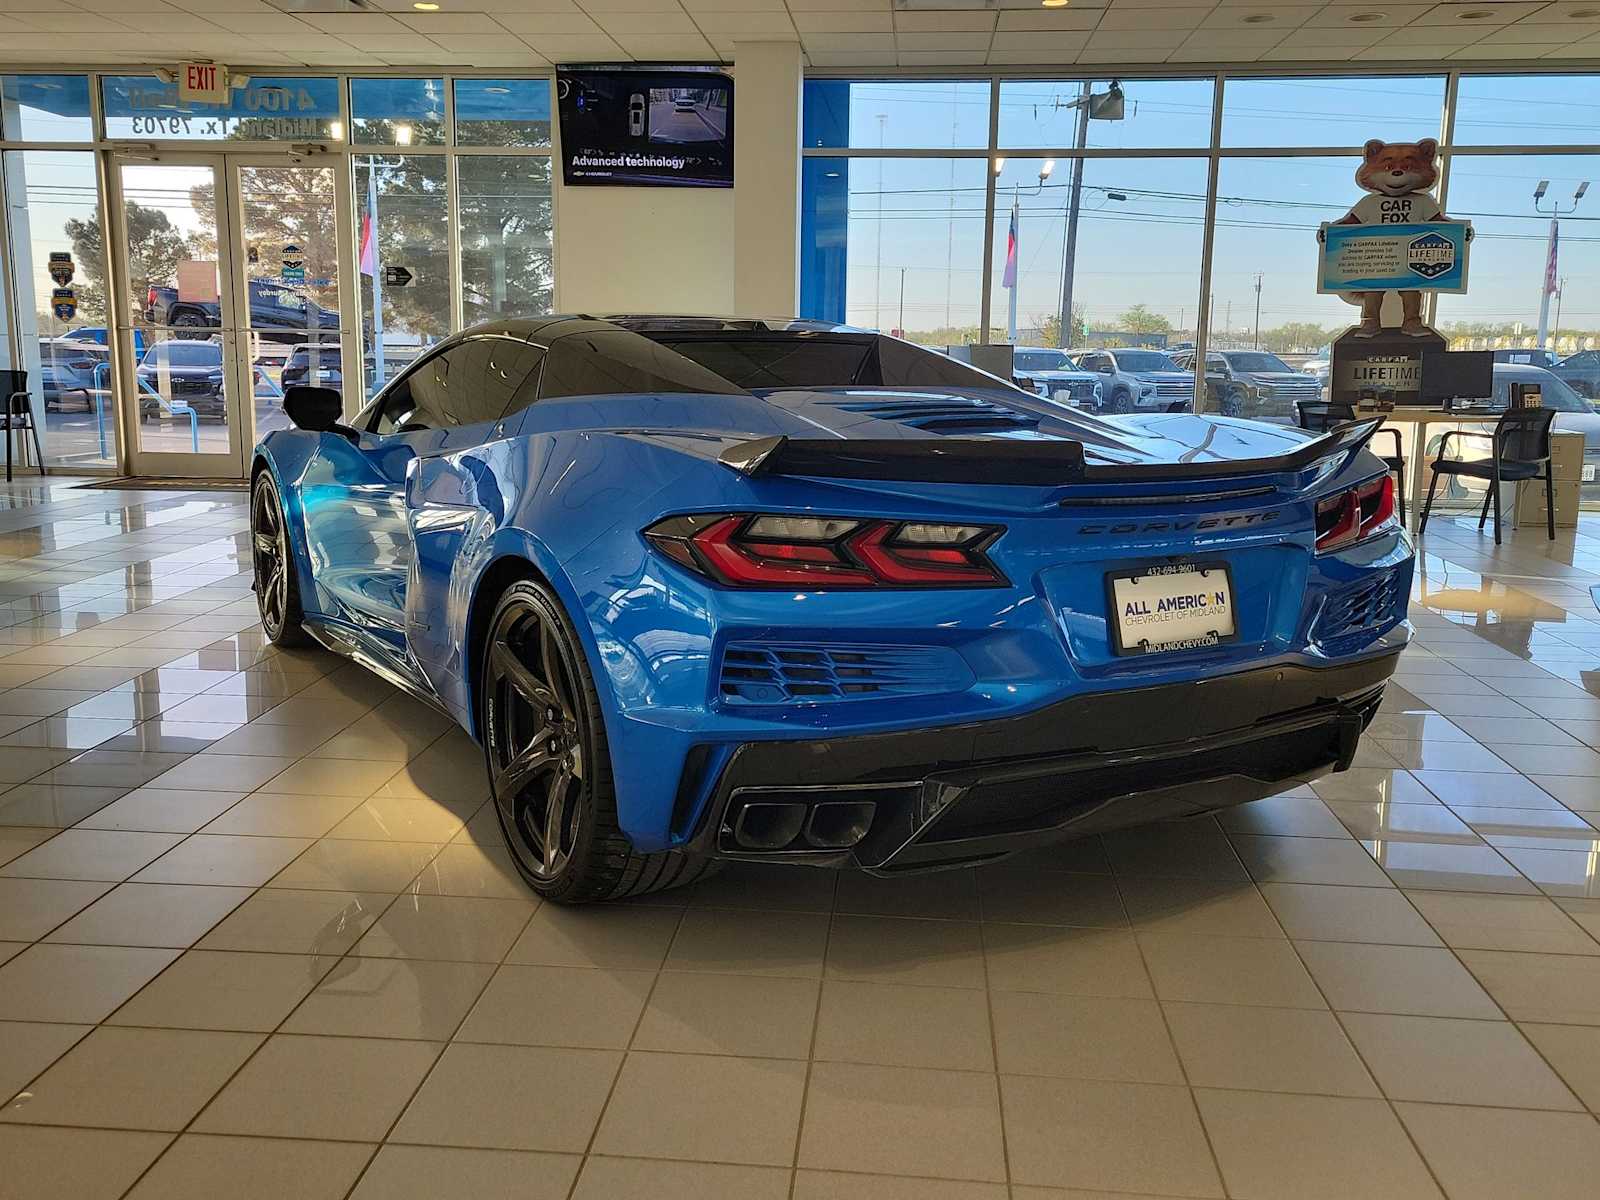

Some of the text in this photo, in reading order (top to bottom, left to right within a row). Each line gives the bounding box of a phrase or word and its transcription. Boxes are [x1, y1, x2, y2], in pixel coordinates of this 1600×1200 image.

[187, 65, 217, 91] EXIT
[572, 155, 625, 167] Advanced
[625, 156, 686, 170] technology
[1380, 199, 1412, 212] CAR
[1381, 212, 1411, 223] FOX
[1409, 249, 1453, 258] LIFETIME
[1352, 367, 1421, 380] LIFETIME
[1078, 512, 1281, 535] CORVETTE
[1125, 591, 1226, 617] ALL AMERICN
[1125, 604, 1226, 627] CHEVROLET OF MIDLAND
[1145, 636, 1219, 654] MIDLANDCHEVY.COM
